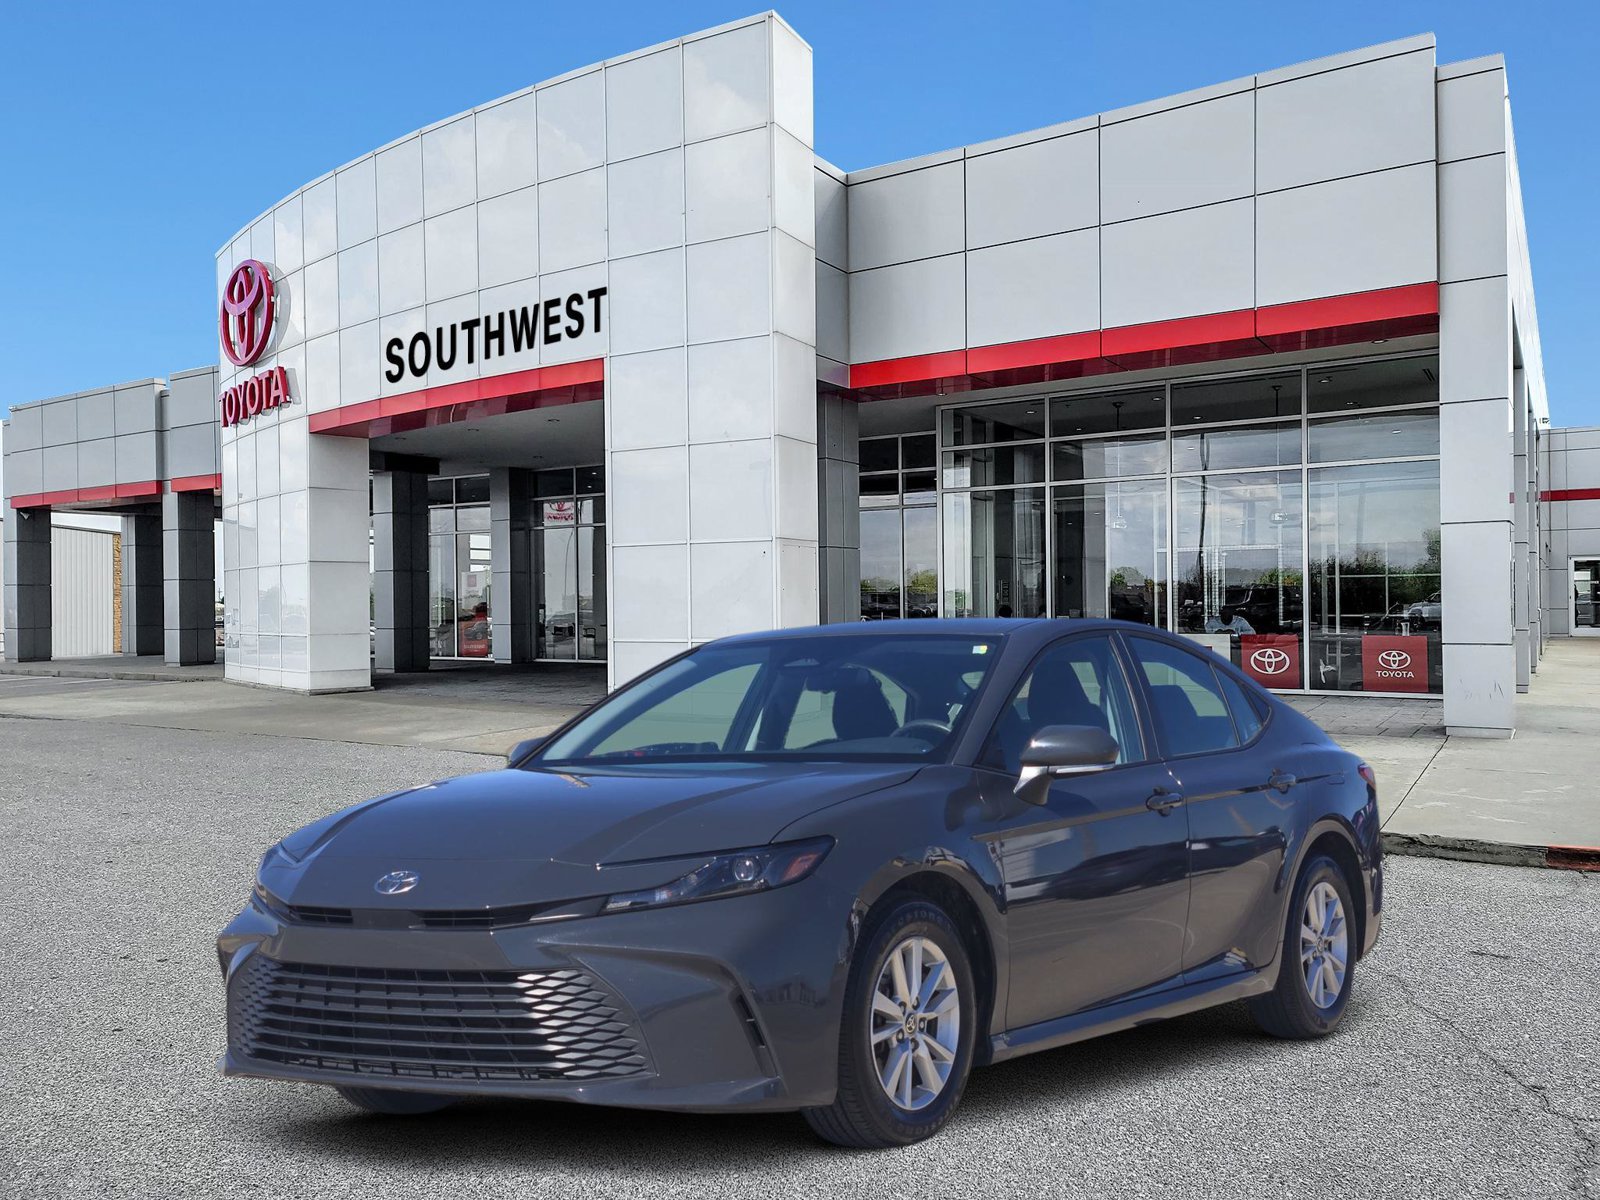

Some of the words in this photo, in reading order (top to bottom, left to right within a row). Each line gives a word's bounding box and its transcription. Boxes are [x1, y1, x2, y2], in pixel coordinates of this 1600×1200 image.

[385, 286, 608, 384] SOUTHWEST
[218, 366, 290, 428] TOYOTA
[1376, 670, 1414, 678] TOYOTA
